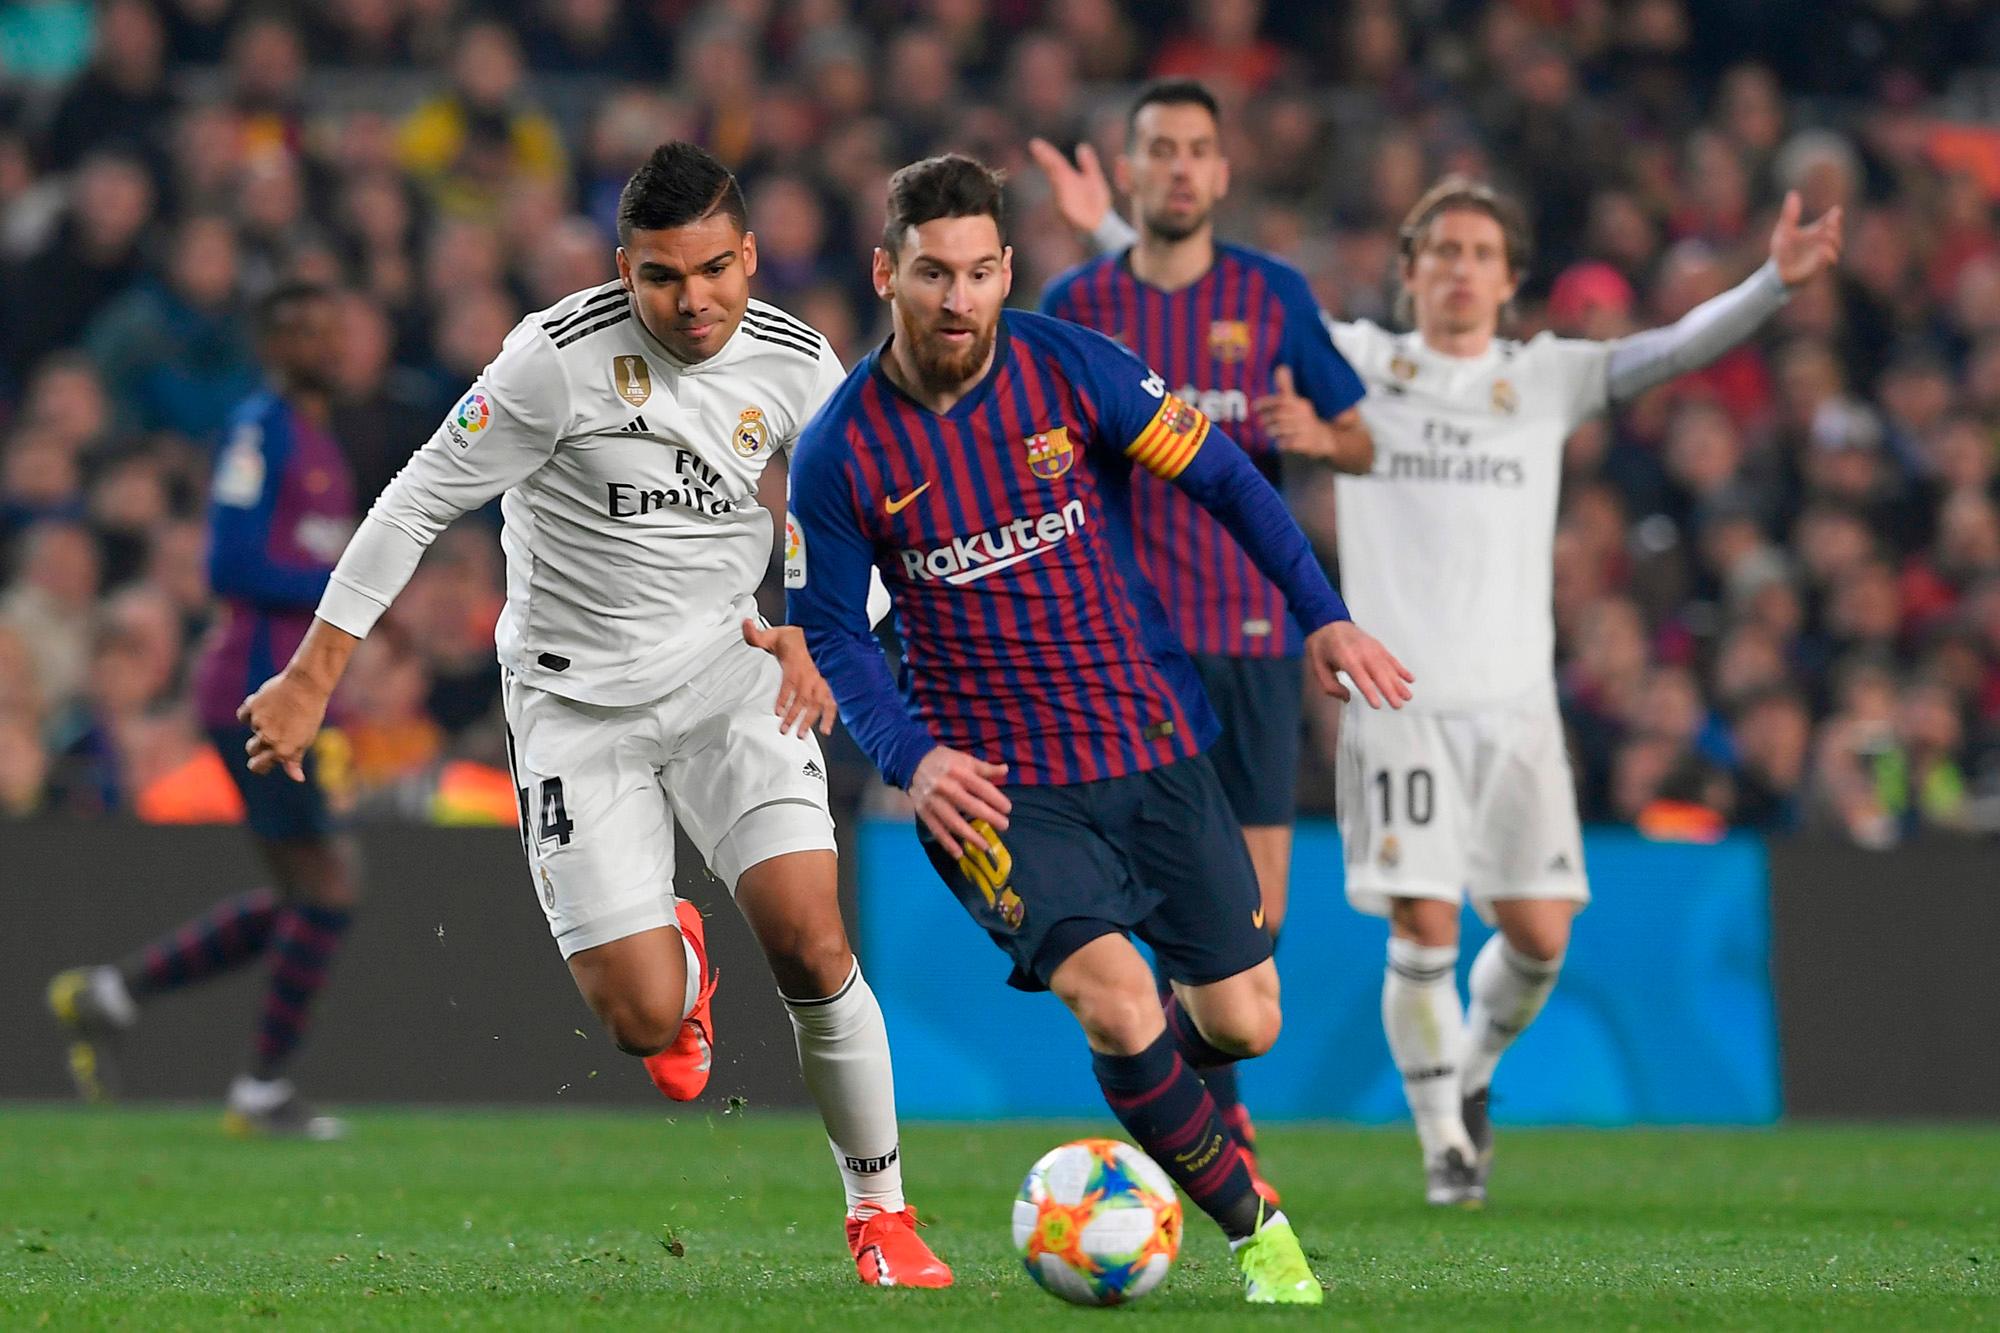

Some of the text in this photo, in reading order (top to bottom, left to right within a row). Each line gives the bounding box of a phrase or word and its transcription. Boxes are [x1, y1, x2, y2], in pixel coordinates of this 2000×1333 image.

[1374, 453, 1526, 487] mirates
[901, 499, 1086, 582] Rakuten
[1376, 768, 1435, 827] 10
